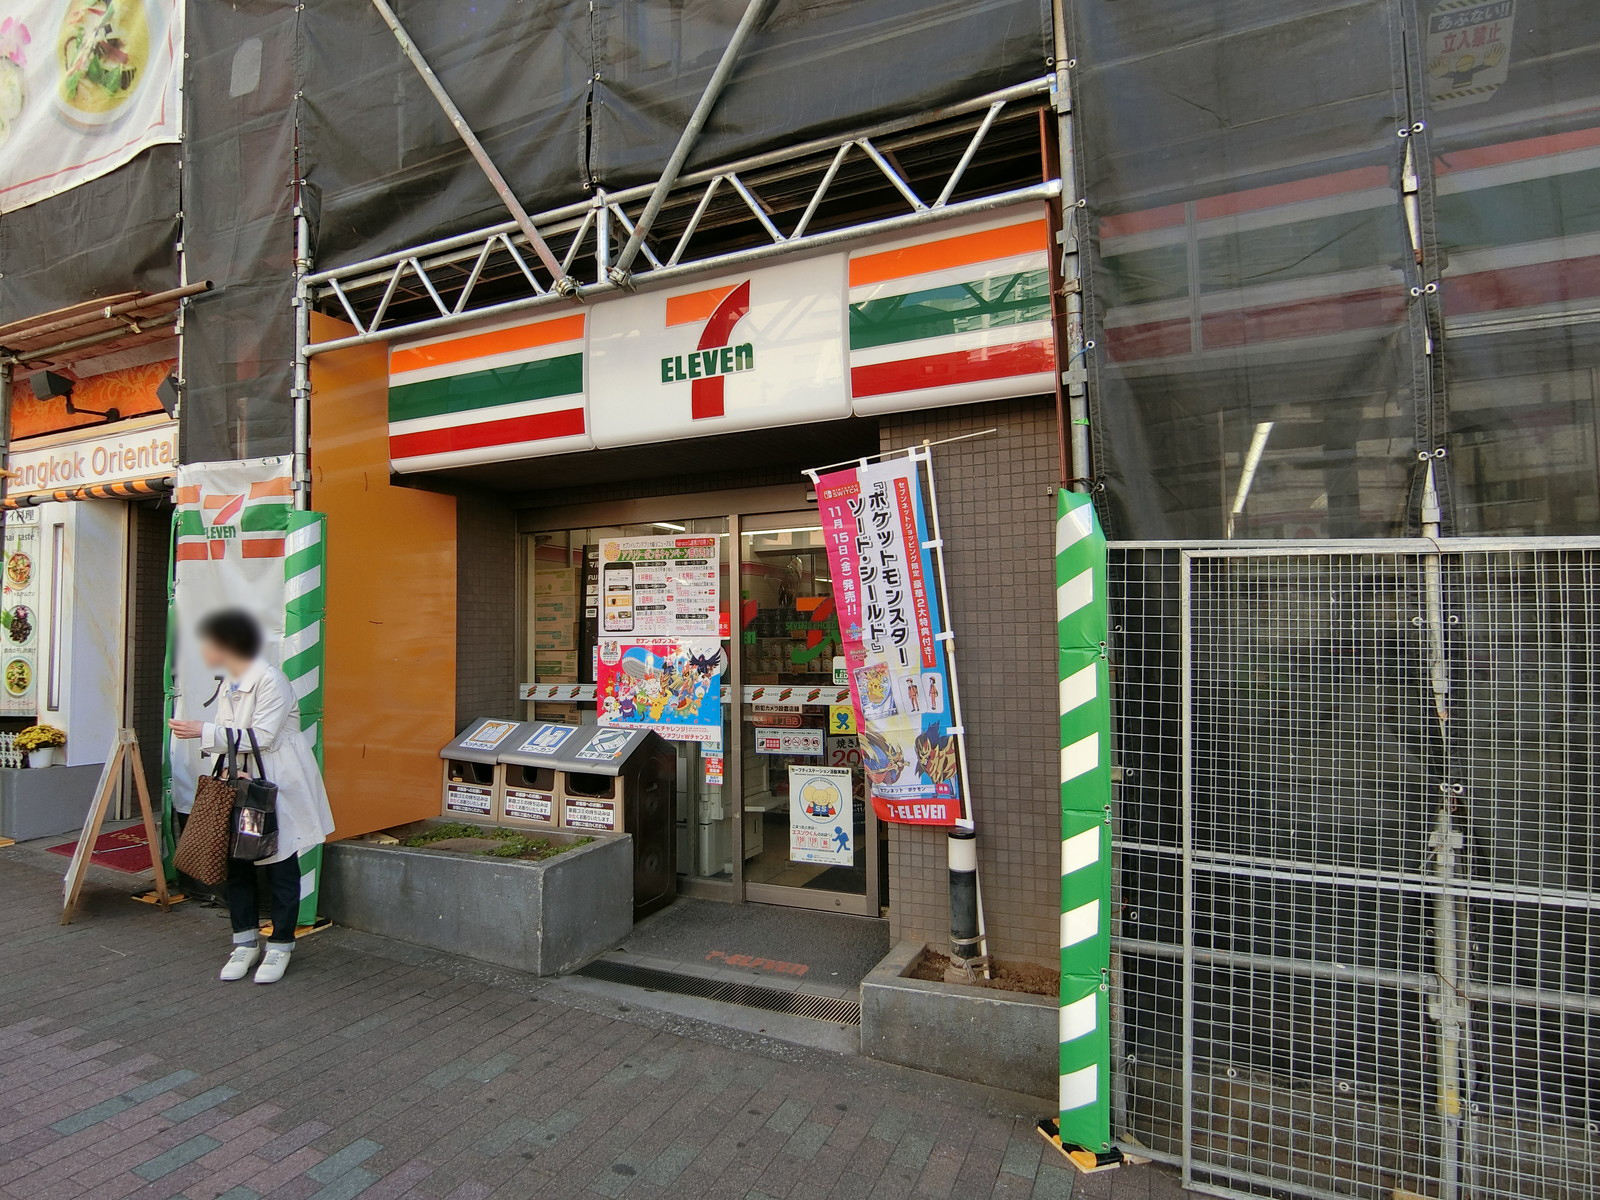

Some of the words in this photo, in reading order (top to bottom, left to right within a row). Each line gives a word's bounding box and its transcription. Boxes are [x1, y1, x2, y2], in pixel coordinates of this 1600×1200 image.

[1441, 23, 1500, 54] 立入禁止
[92, 433, 179, 475] Oriental
[832, 488, 859, 498] SWITCH
[5, 509, 35, 524] イ料理
